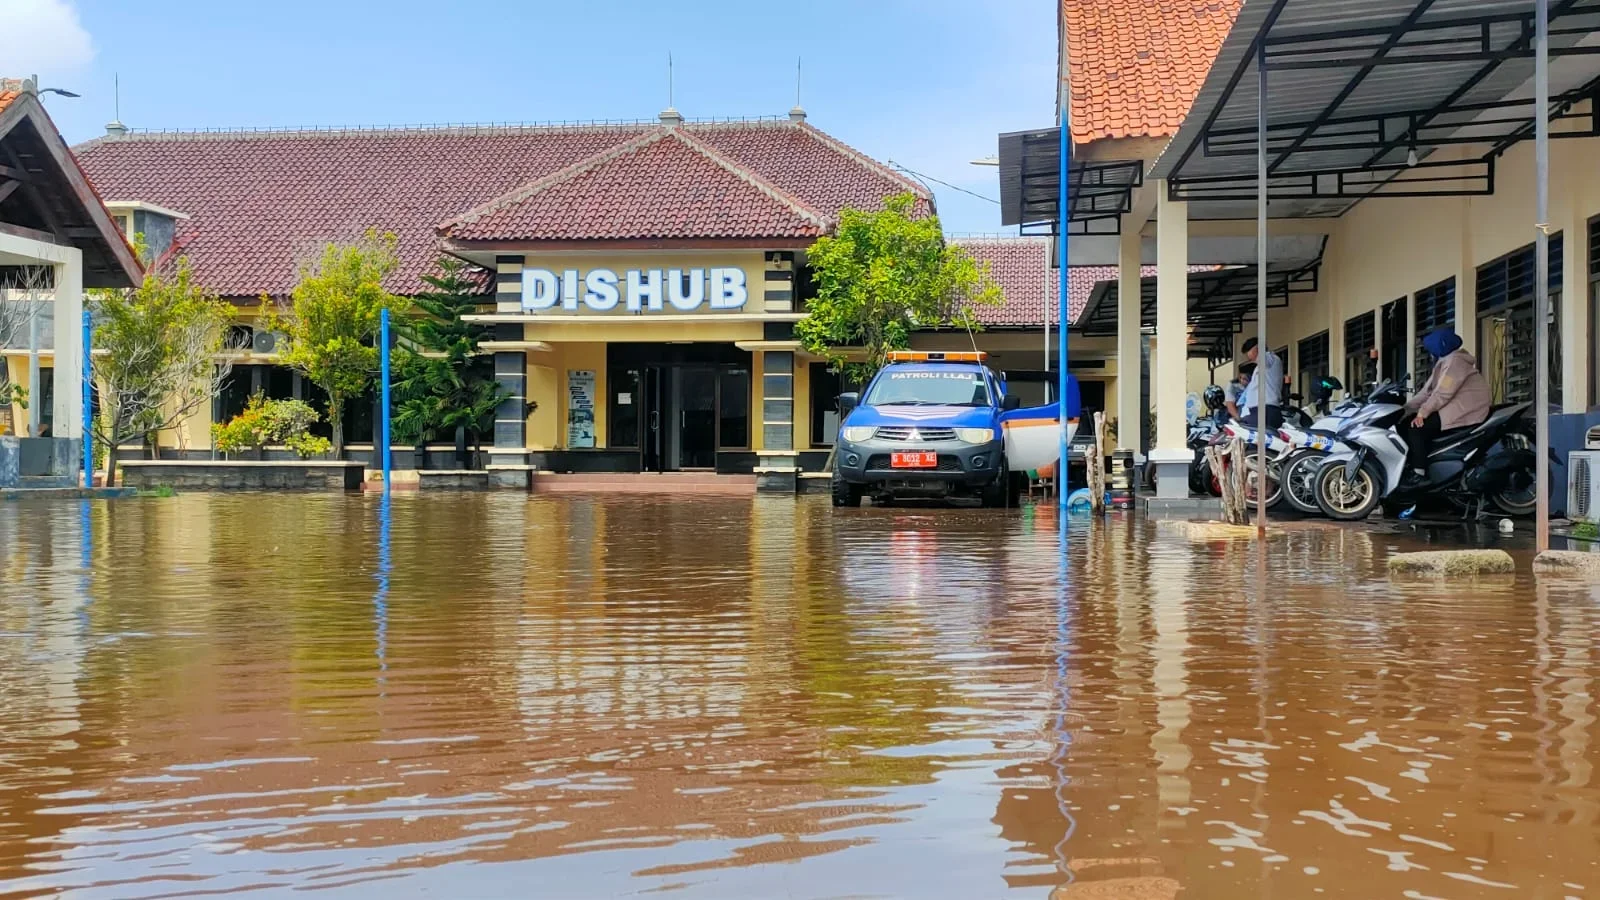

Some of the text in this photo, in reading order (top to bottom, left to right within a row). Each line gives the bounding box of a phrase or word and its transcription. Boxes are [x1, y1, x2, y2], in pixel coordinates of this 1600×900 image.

[521, 267, 748, 311] DISHUB
[891, 372, 973, 380] PATROLI LLAJ
